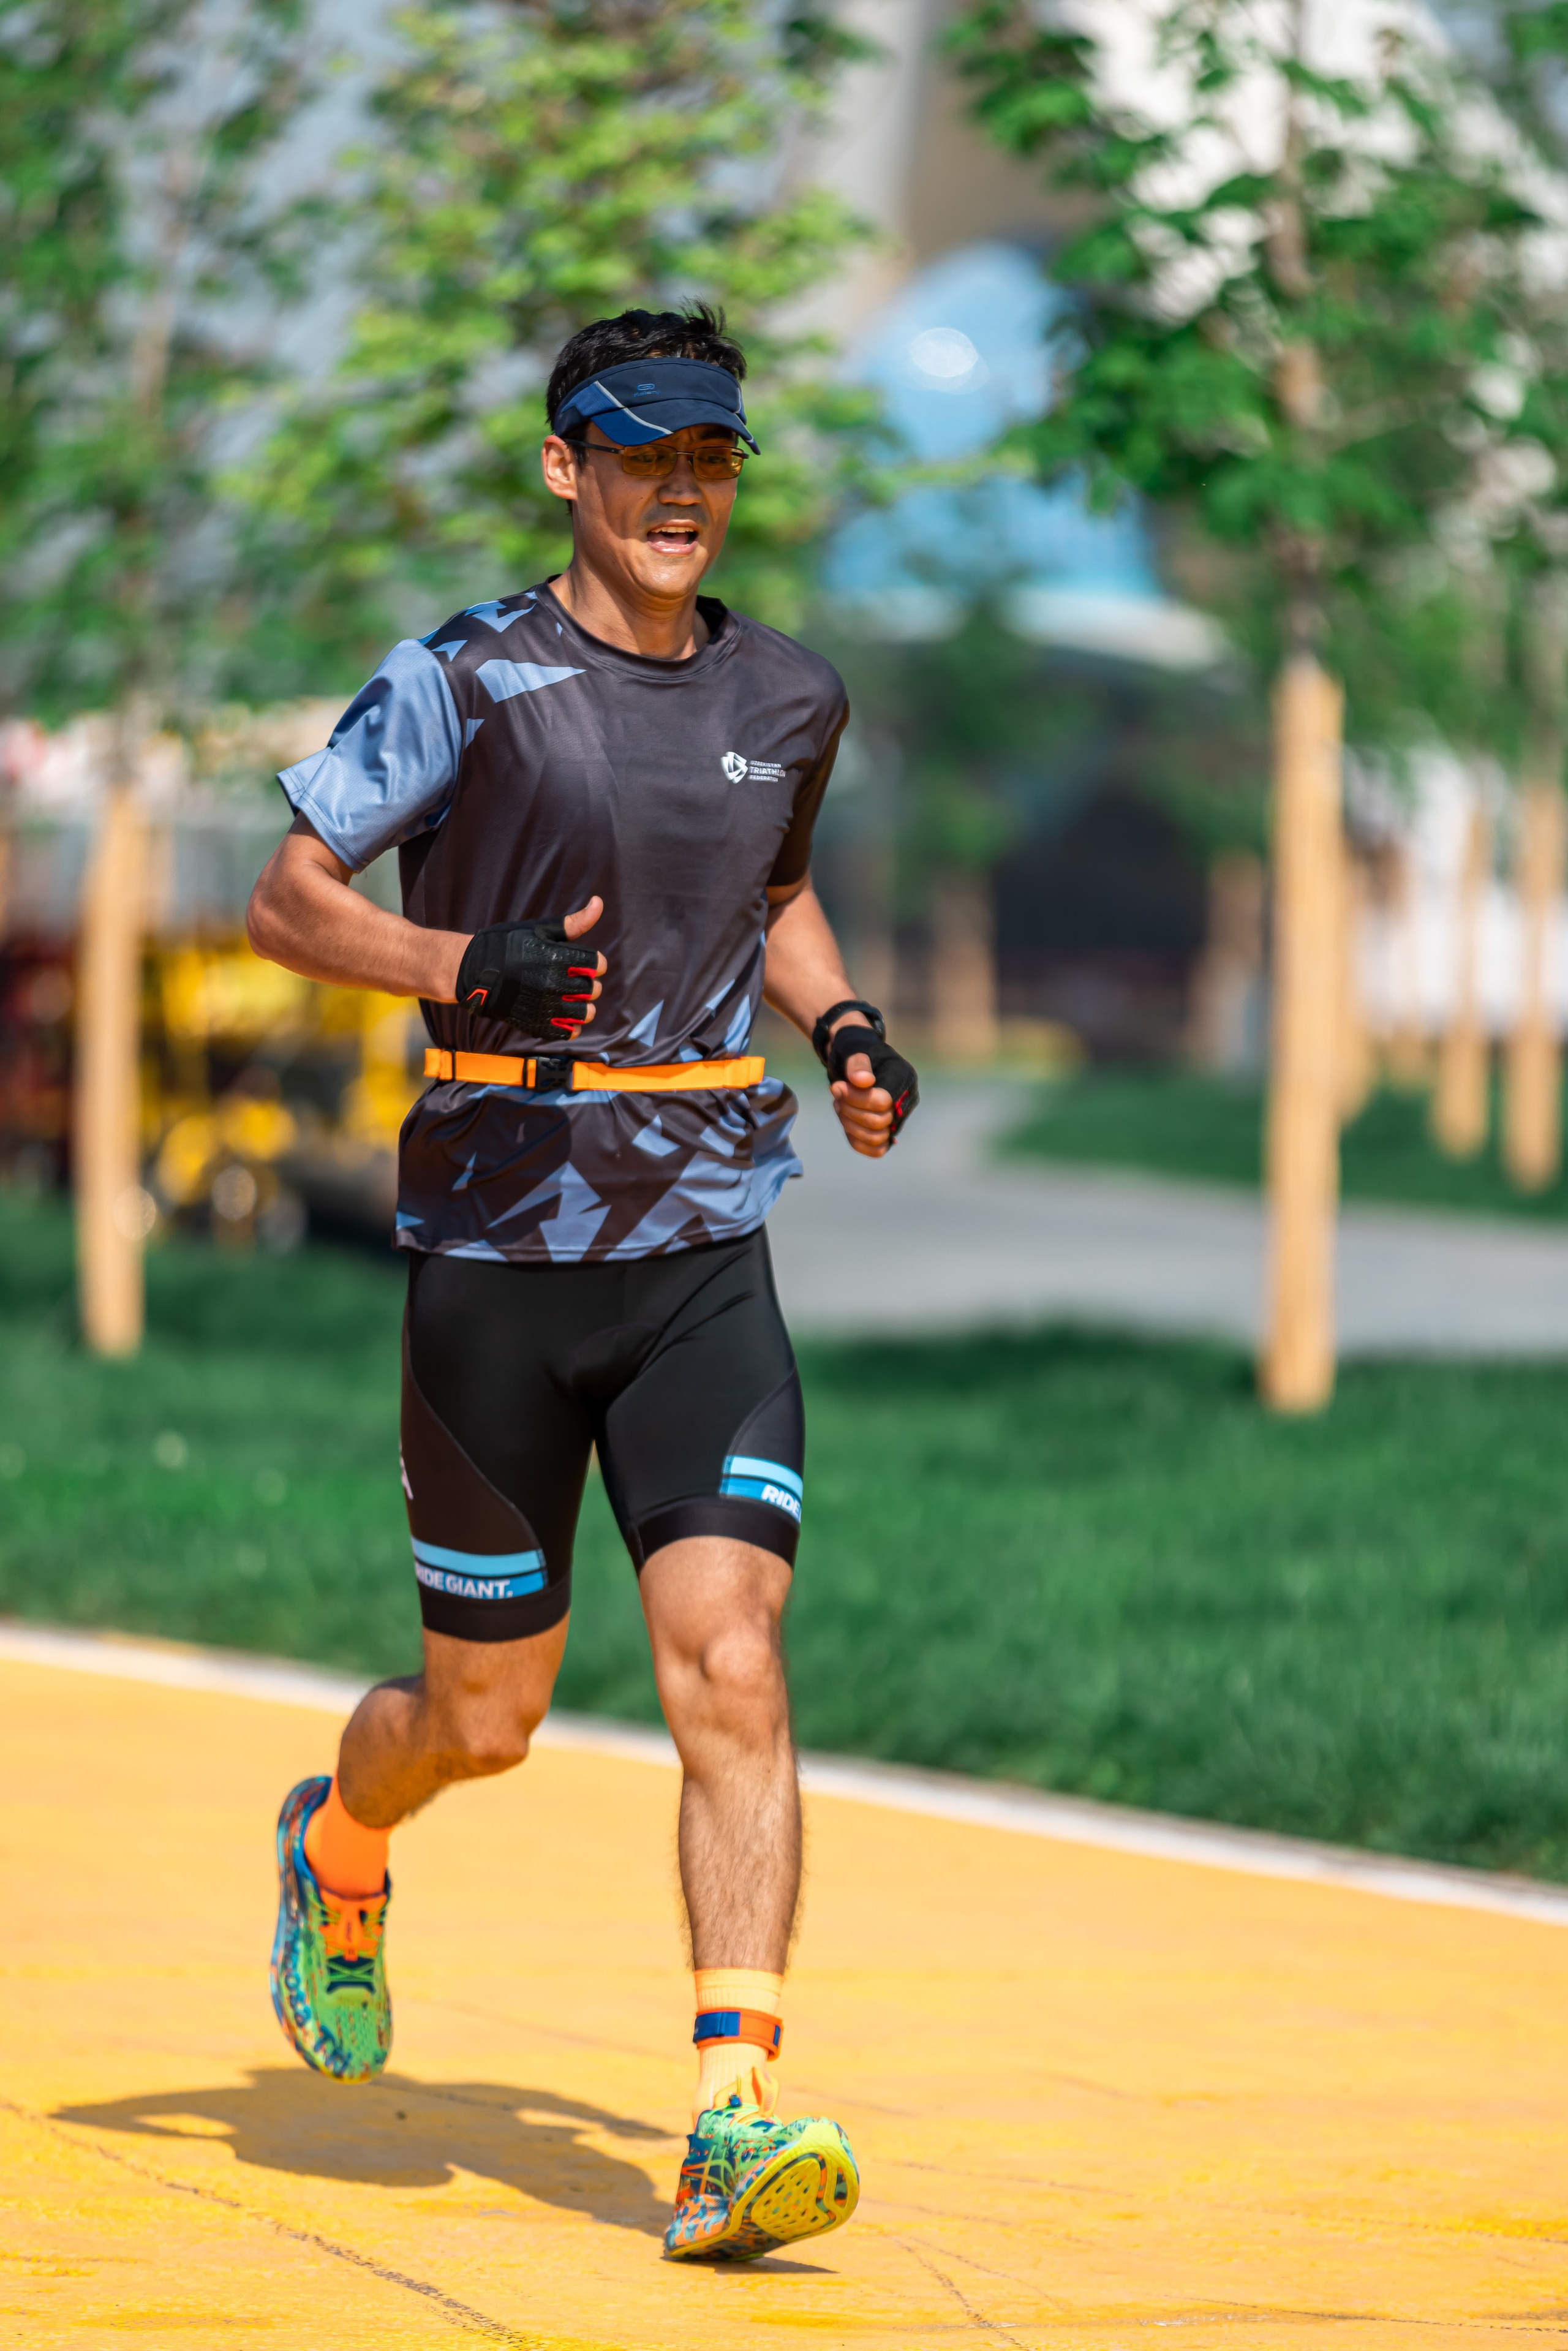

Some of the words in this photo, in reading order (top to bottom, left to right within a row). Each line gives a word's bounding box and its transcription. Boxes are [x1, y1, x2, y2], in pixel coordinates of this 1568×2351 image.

[750, 766, 786, 777] TRIATHLON
[761, 1484, 801, 1521] RIDE
[445, 1574, 513, 1599] GIANT.
